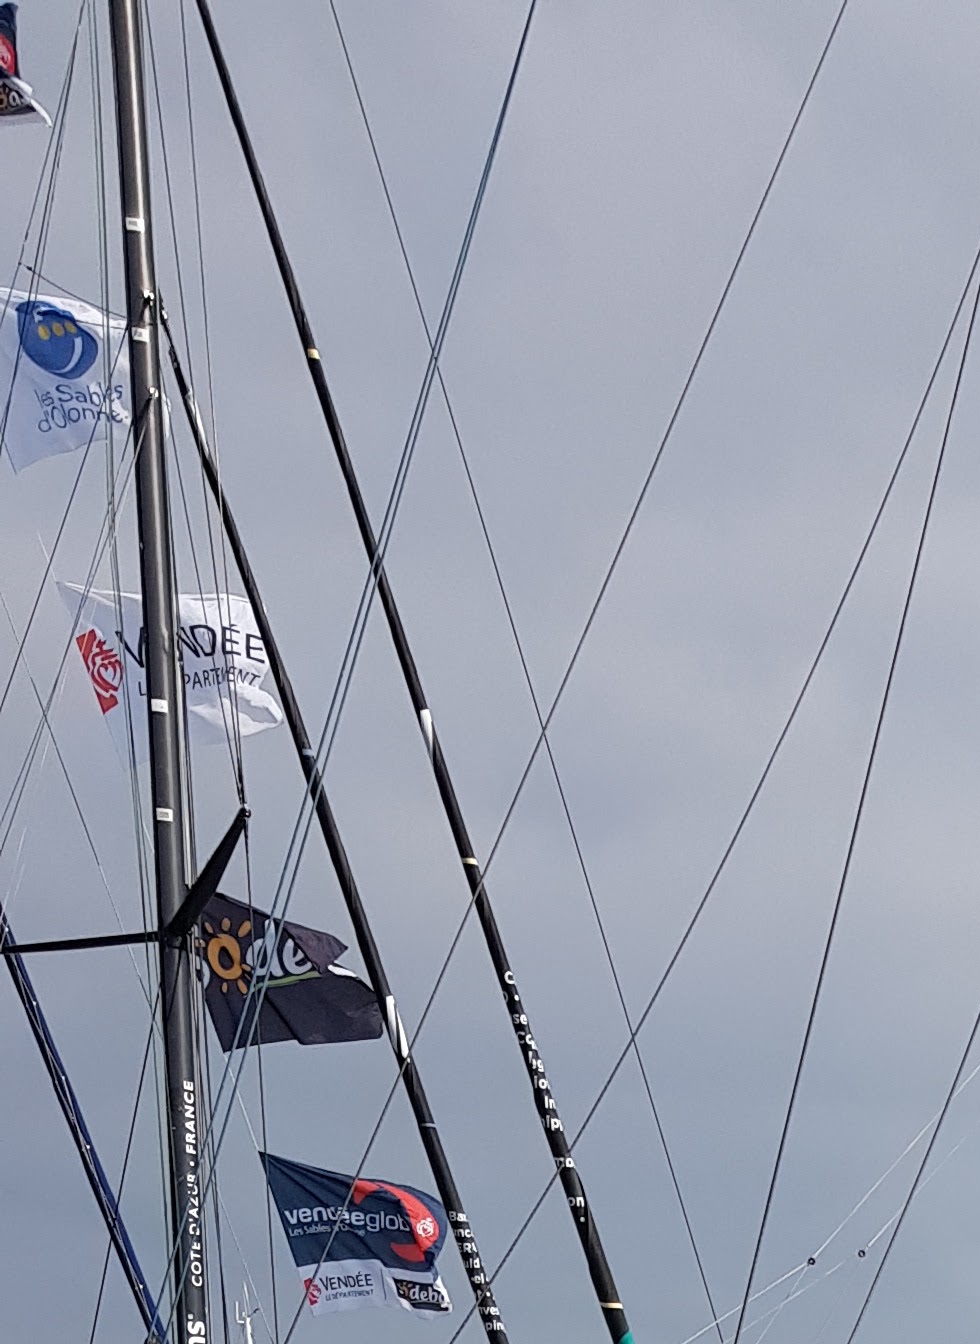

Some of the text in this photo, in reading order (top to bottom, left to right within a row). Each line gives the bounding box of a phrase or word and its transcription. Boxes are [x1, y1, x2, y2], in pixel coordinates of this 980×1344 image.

[115, 624, 266, 668] VNDÉE
[183, 1080, 197, 1156] FRANCE
[319, 1271, 374, 1291] VENDÉE
